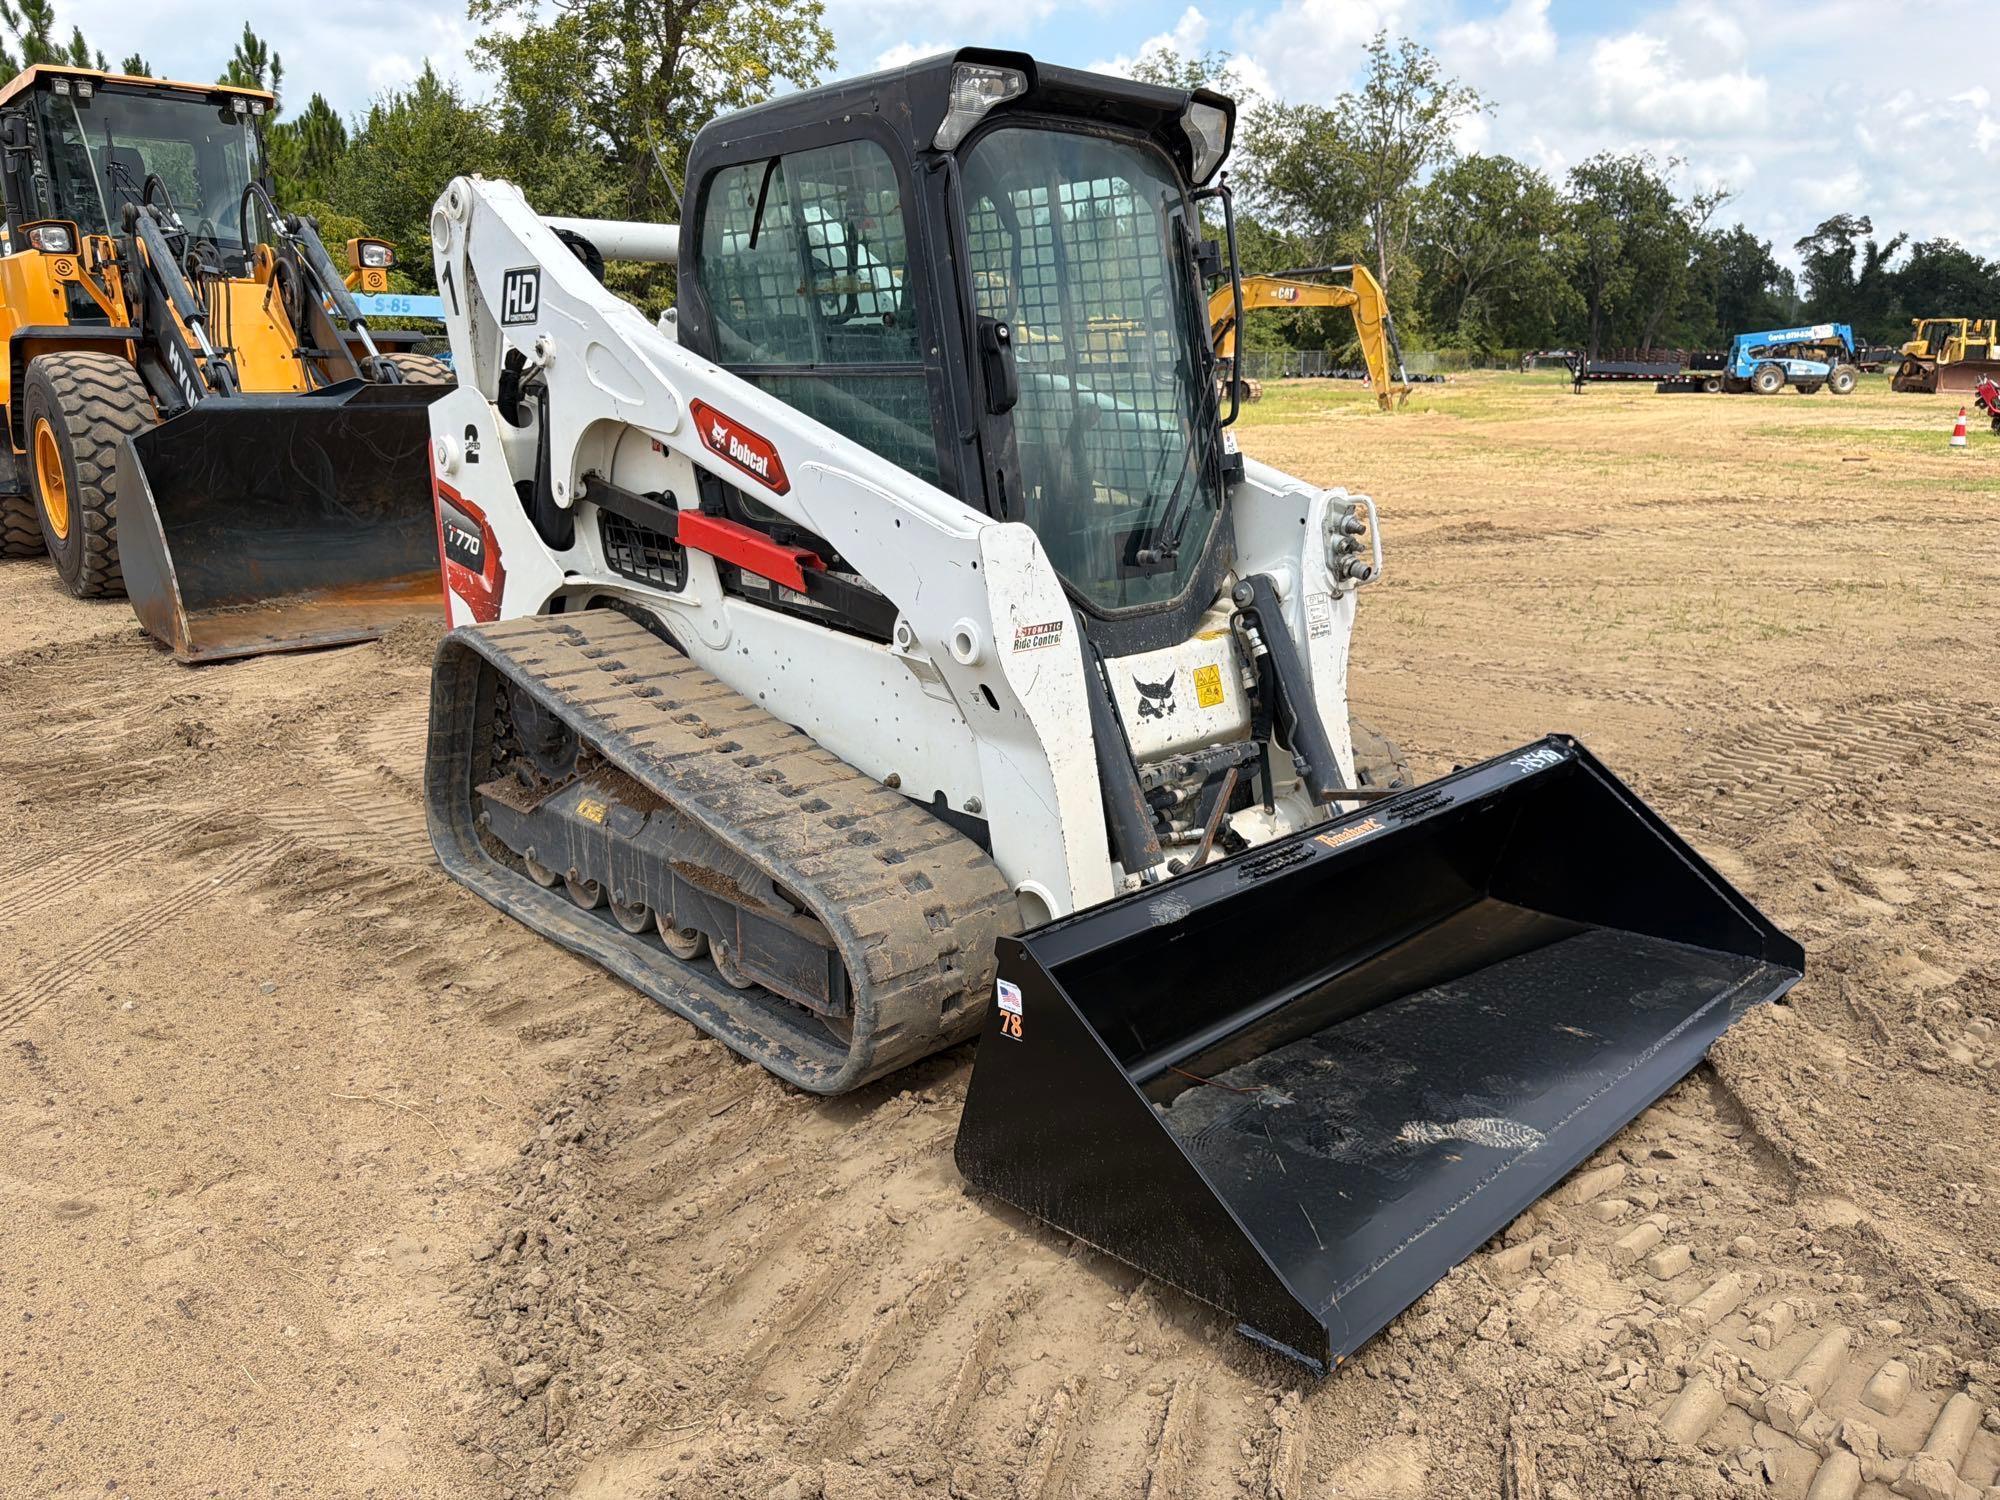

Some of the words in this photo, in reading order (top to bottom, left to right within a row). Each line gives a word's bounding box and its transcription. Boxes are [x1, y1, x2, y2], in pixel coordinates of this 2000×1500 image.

[374, 297, 411, 313] S-85
[442, 261, 460, 316] 1
[504, 273, 537, 322] HD
[1278, 286, 1296, 300] CAT
[464, 423, 480, 464] 2
[729, 435, 769, 478] Bobcat
[1013, 637, 1032, 651] Ride
[1000, 1009, 1023, 1038] 78
